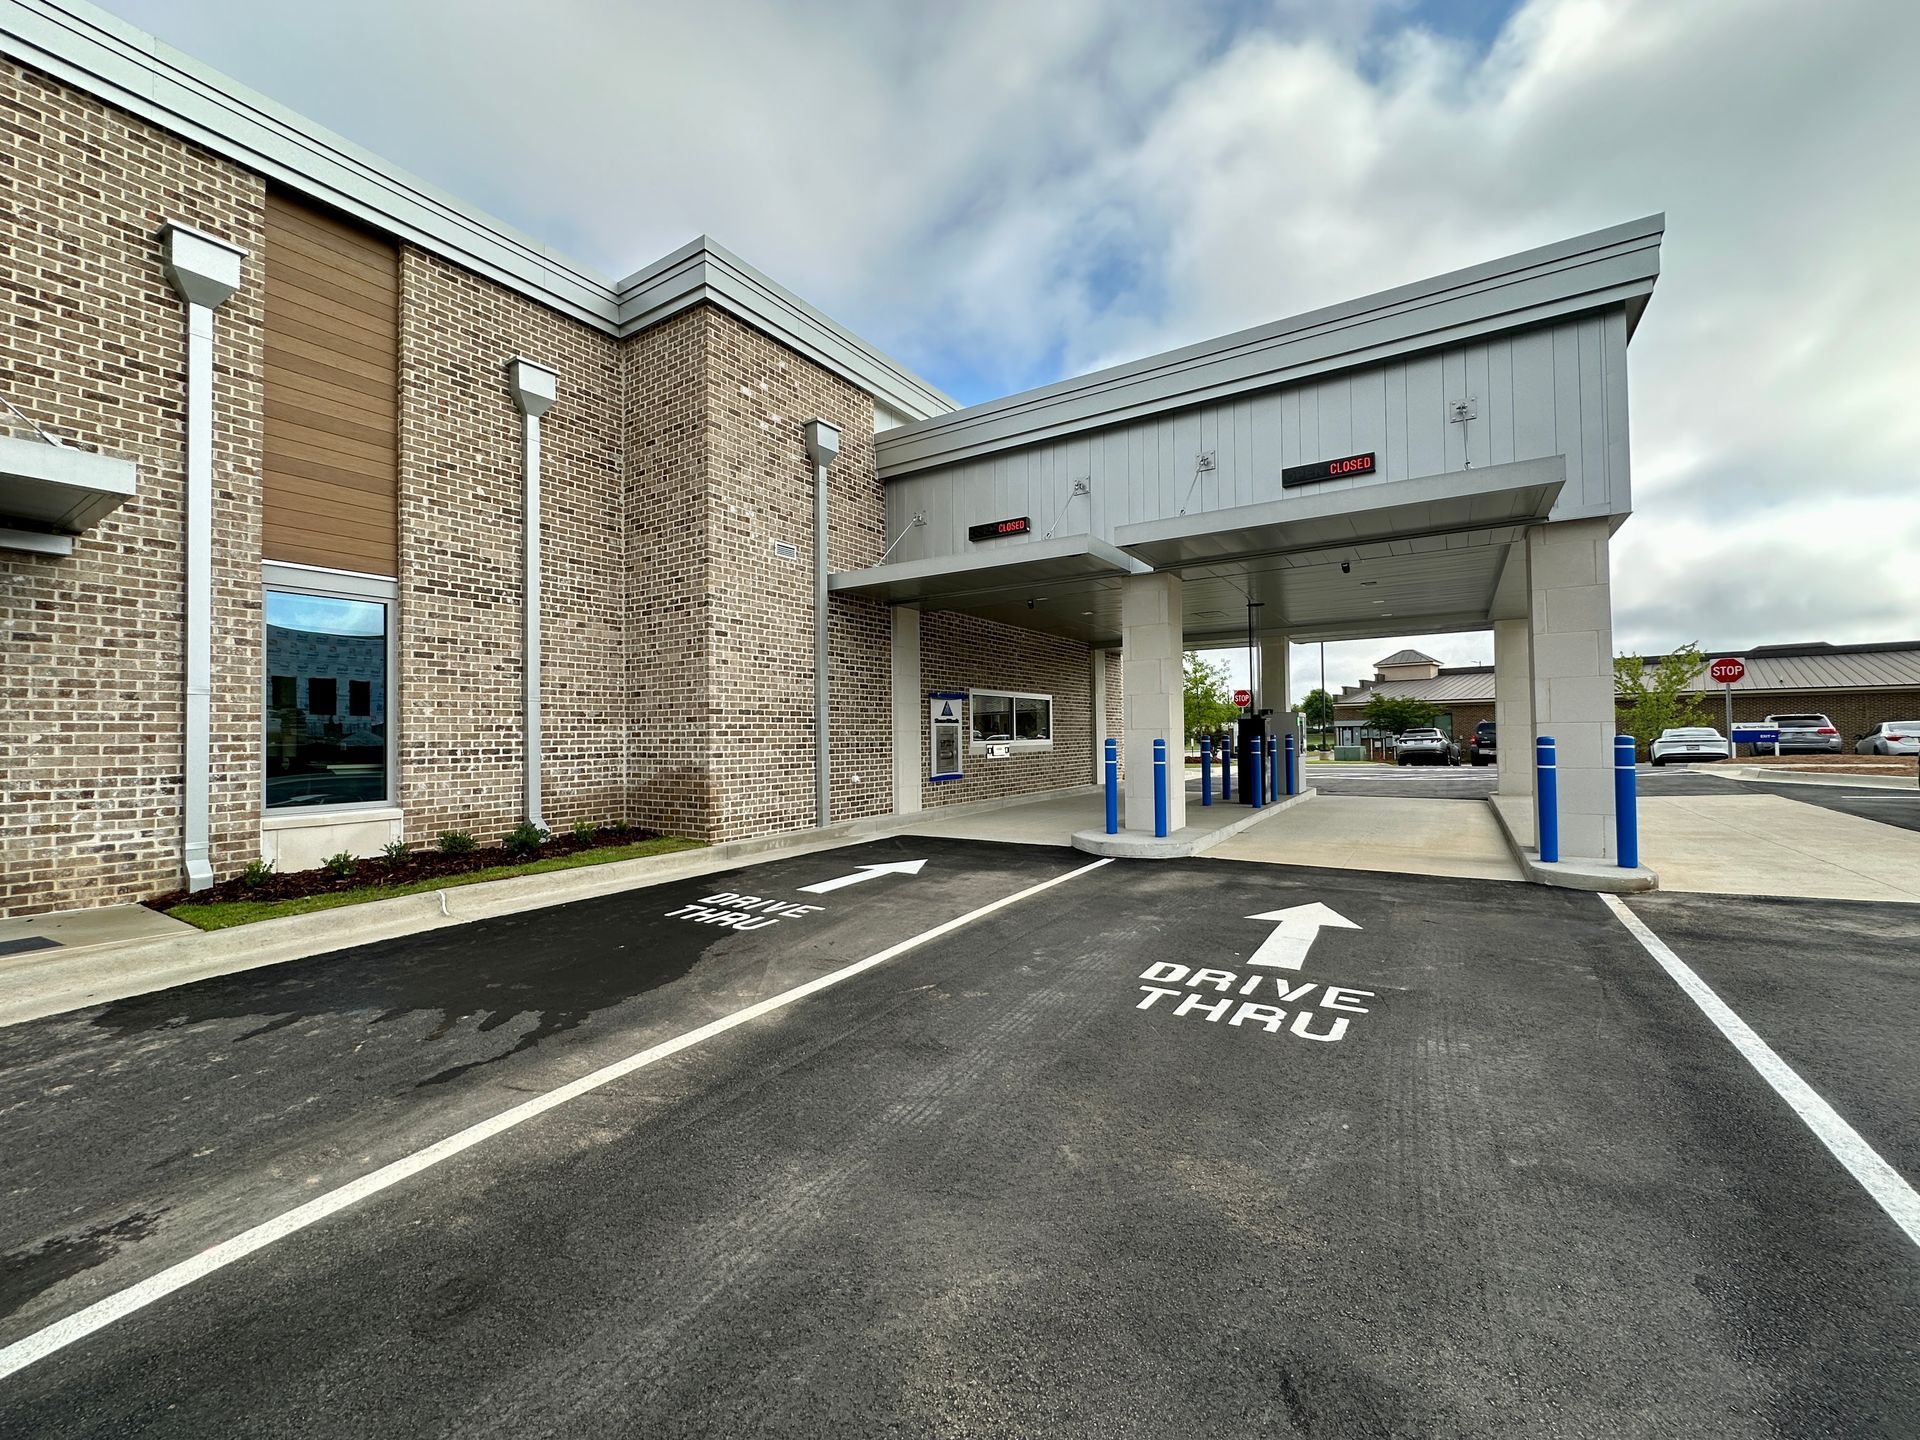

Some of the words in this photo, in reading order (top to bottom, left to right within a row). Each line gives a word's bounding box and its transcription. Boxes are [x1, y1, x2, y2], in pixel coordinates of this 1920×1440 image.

[1330, 457, 1371, 474] CLOSED
[998, 520, 1025, 533] CLOSED
[1713, 666, 1742, 676] STOP
[1235, 694, 1249, 702] STOP
[697, 892, 826, 919] DRIVE
[664, 904, 780, 931] THRU
[1138, 961, 1375, 1014] DRIVE
[1135, 985, 1350, 1042] THRU
